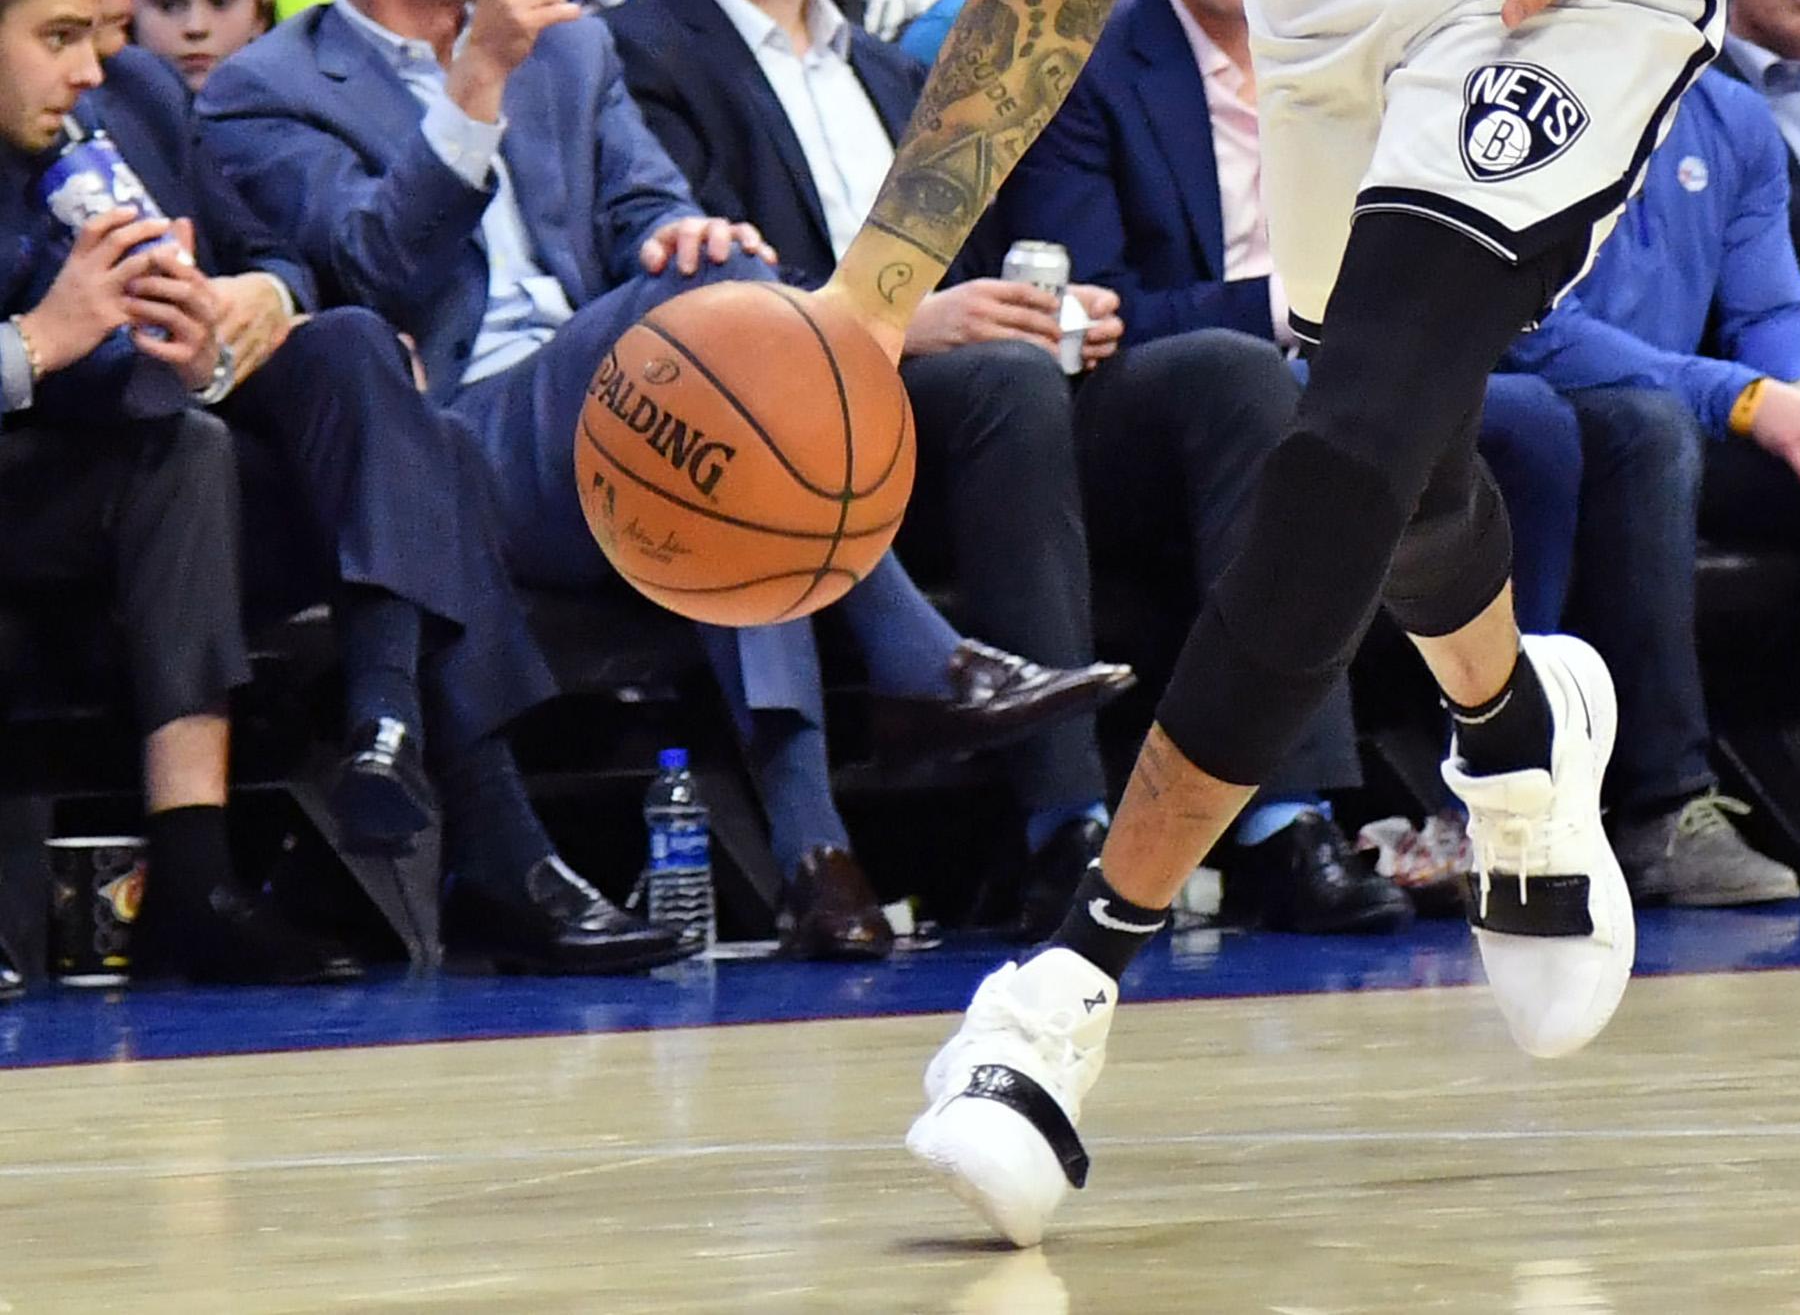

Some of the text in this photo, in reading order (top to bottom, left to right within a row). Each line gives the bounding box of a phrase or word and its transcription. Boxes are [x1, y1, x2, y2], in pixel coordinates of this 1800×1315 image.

[1470, 66, 1579, 146] NETS
[1482, 118, 1515, 161] B
[588, 349, 736, 496] PALDING
